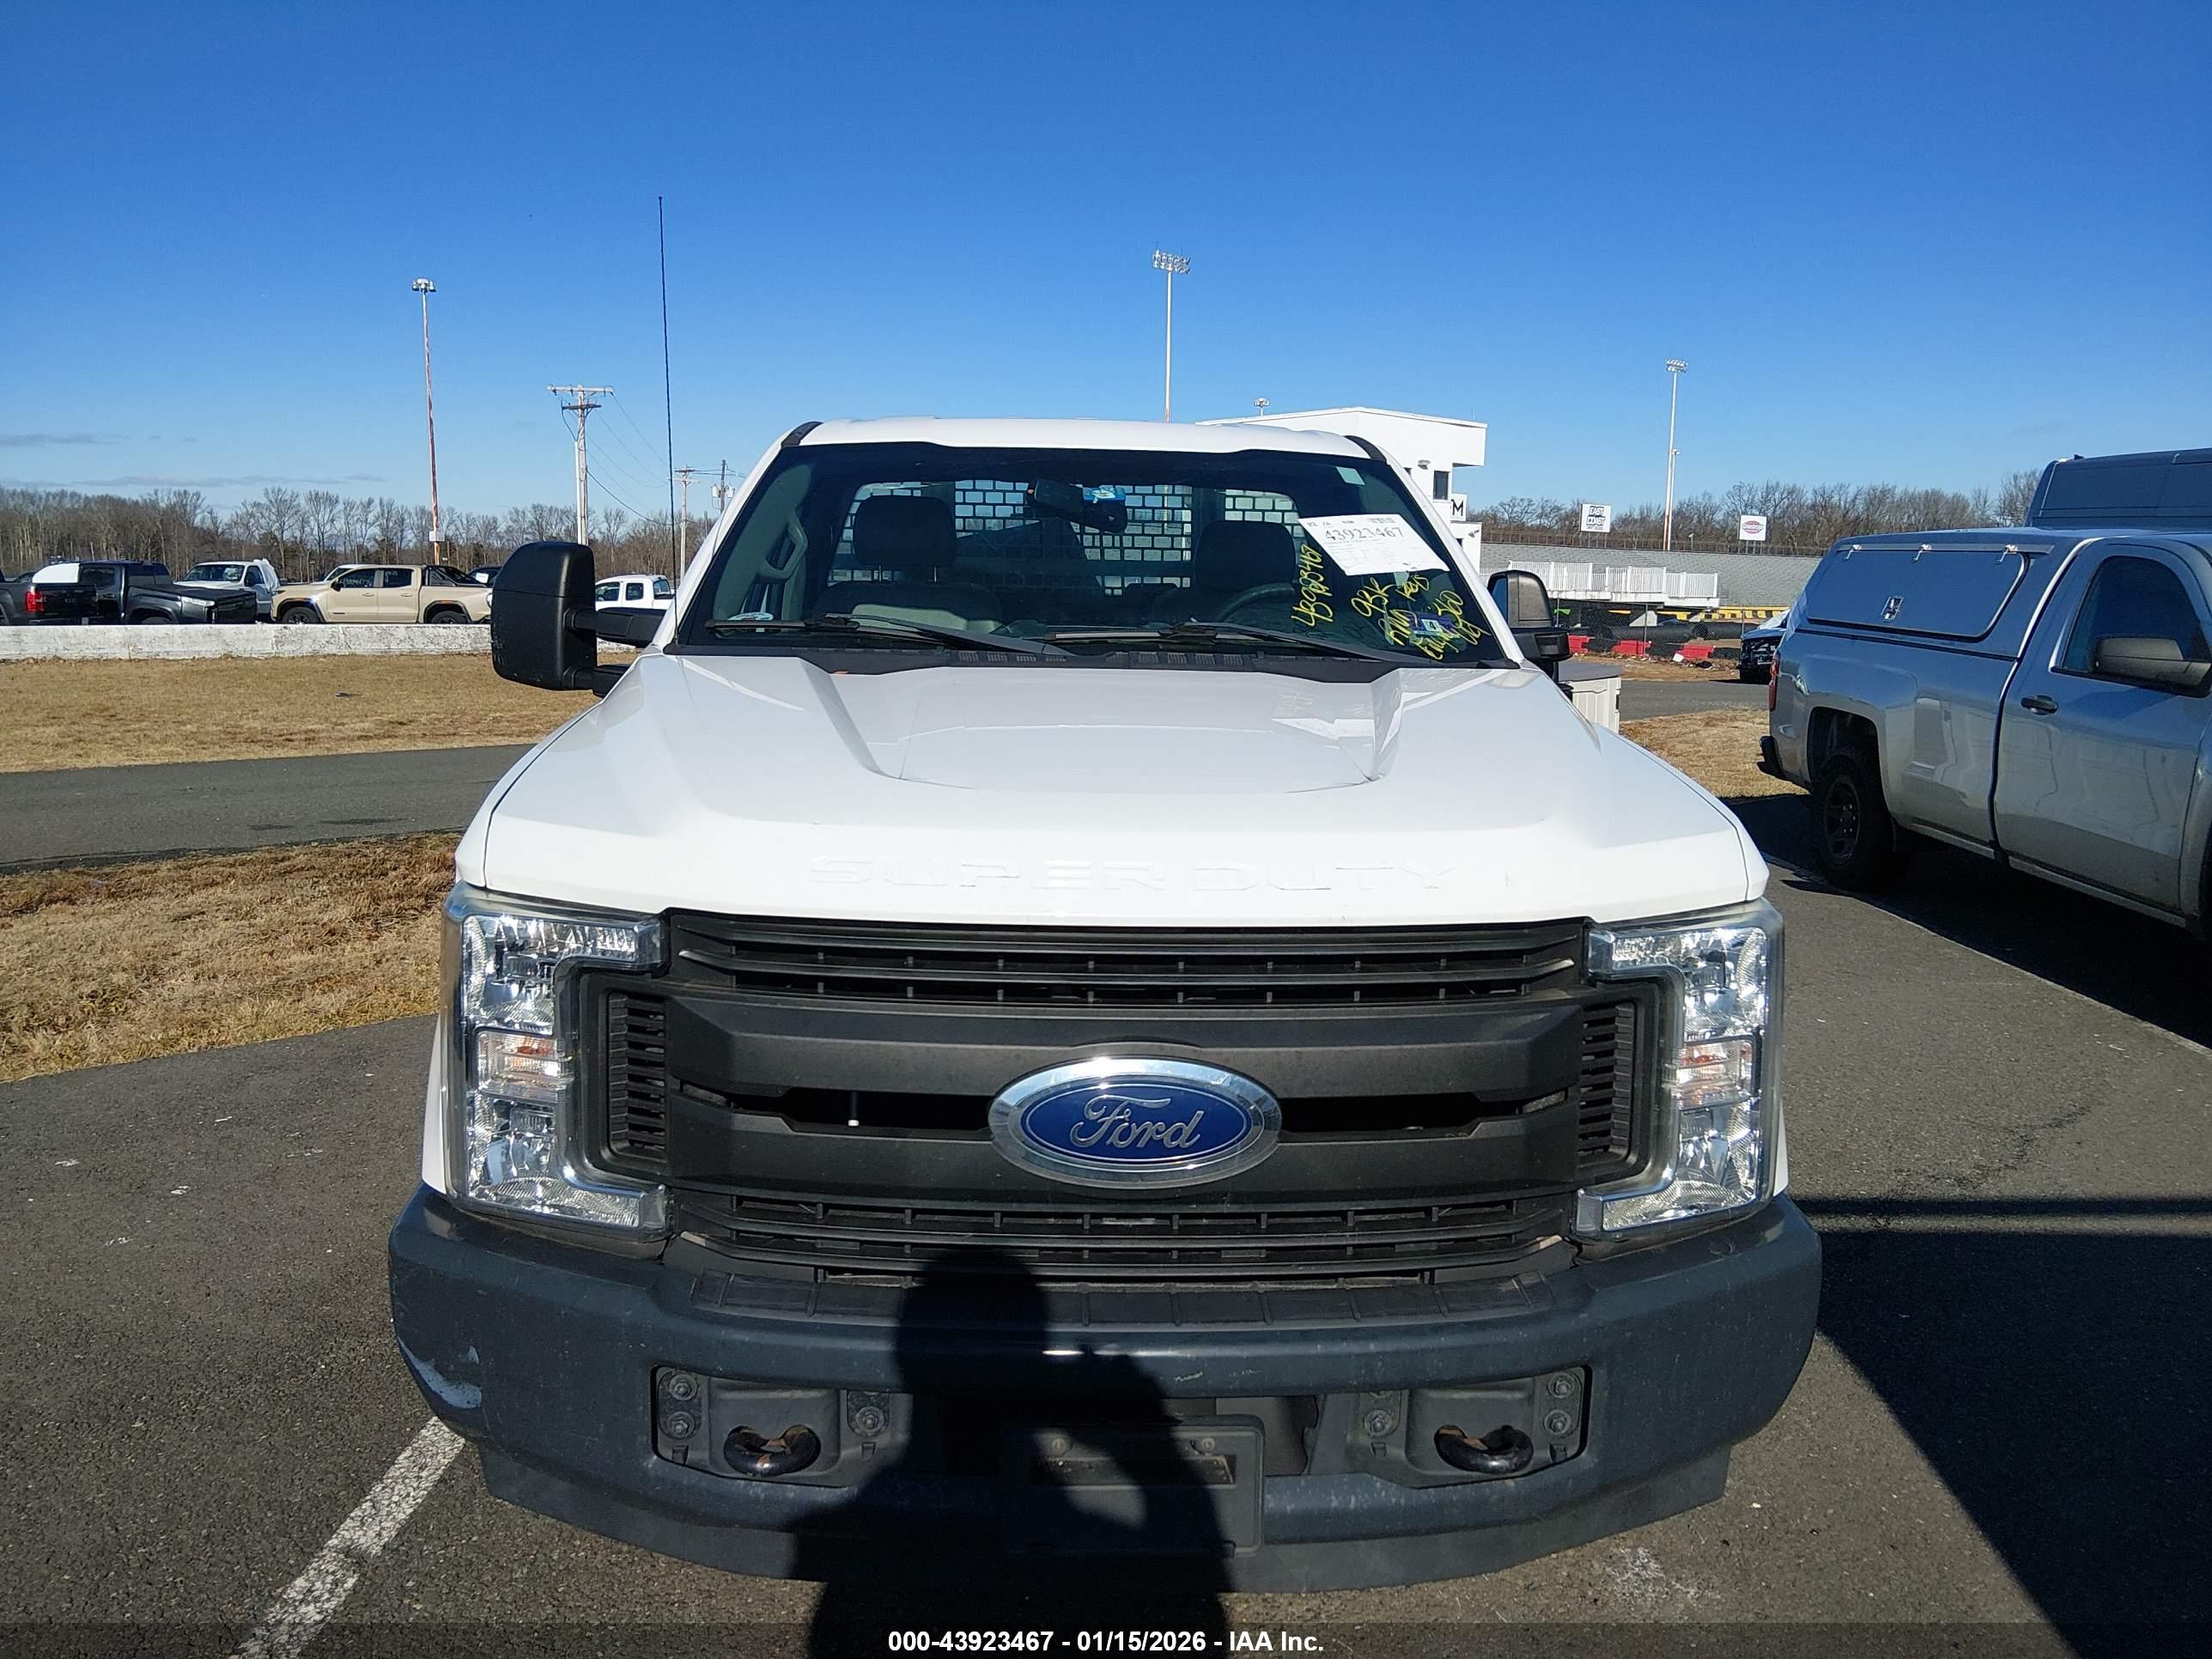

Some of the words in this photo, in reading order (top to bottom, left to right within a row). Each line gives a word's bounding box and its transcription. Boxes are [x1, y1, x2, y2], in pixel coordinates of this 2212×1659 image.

[1450, 498, 1464, 516] M
[1589, 506, 1604, 516] EAST
[1325, 527, 1404, 541] 43923467
[1428, 621, 1437, 630] 4
[810, 855, 1168, 890] SUPER
[1188, 859, 1456, 890] DUTY
[1070, 1095, 1204, 1148] Ford
